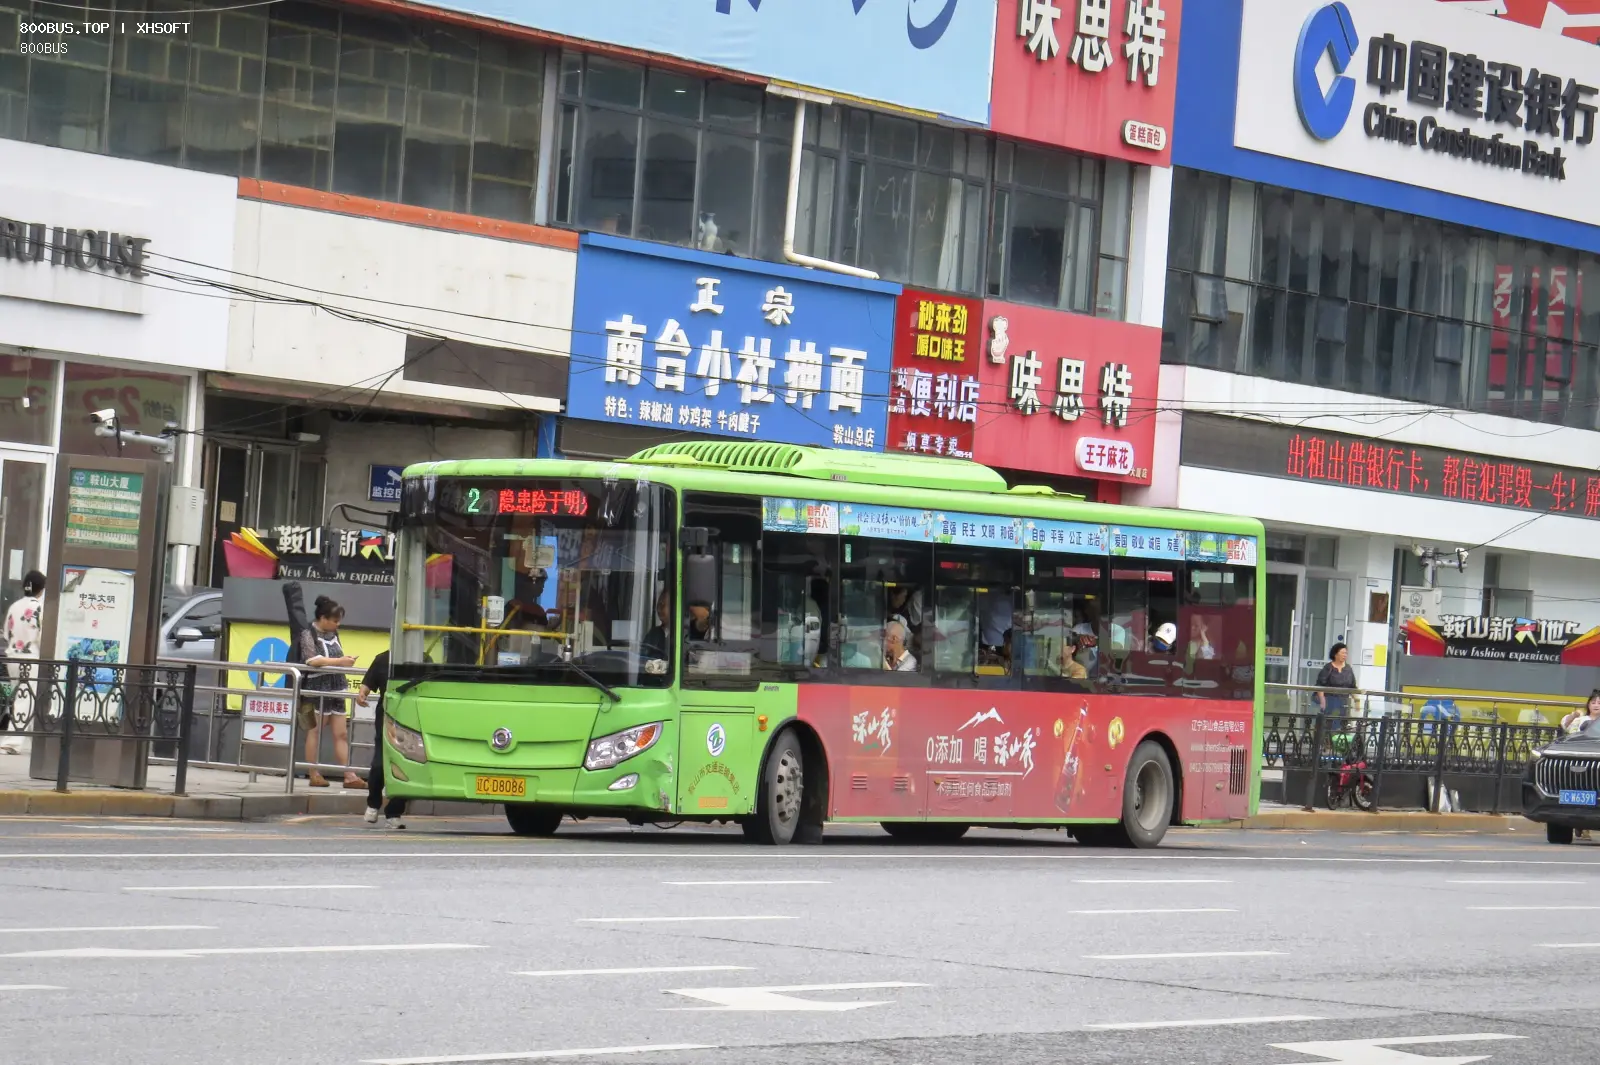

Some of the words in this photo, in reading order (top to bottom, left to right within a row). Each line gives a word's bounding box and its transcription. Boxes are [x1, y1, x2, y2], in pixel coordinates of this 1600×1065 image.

[1017, 0, 1166, 86] 味思特
[1366, 33, 1599, 145] 中国建设银行
[1129, 123, 1161, 147] 蛋糕面包
[1364, 102, 1417, 146] China
[1522, 140, 1567, 180] Bank
[51, 226, 152, 278] HOUSE
[690, 277, 795, 326] 正宗
[917, 299, 968, 336] 秒来劲
[909, 368, 980, 423] 便利店
[1008, 350, 1133, 428] 味思特
[832, 424, 875, 448] 鞍山总店
[1085, 443, 1129, 470] 王子麻花
[90, 474, 130, 490] 鞍山大厦
[467, 487, 480, 513] 2
[942, 520, 957, 536] 富强
[962, 523, 976, 537] 民主
[981, 525, 995, 538] 文明
[1000, 525, 1014, 540] 和谐
[1031, 529, 1046, 542] 自由
[1050, 530, 1064, 543] 平等
[1069, 531, 1082, 546] 公正
[1087, 533, 1100, 547] 法治
[1114, 534, 1128, 548] 爱国
[1131, 536, 1145, 550] 敬业
[1148, 537, 1161, 551] 诚信
[1166, 538, 1180, 552] 友善
[278, 565, 302, 577] New
[78, 600, 115, 611] 天人合一
[79, 593, 116, 604] 中华文明
[1446, 646, 1467, 657] New
[1470, 647, 1505, 659] fashion
[1509, 651, 1560, 664] experience
[249, 700, 289, 714] 请您排队乘车
[260, 724, 275, 741] 2
[926, 735, 962, 764] 0添加
[974, 736, 987, 765] 喝
